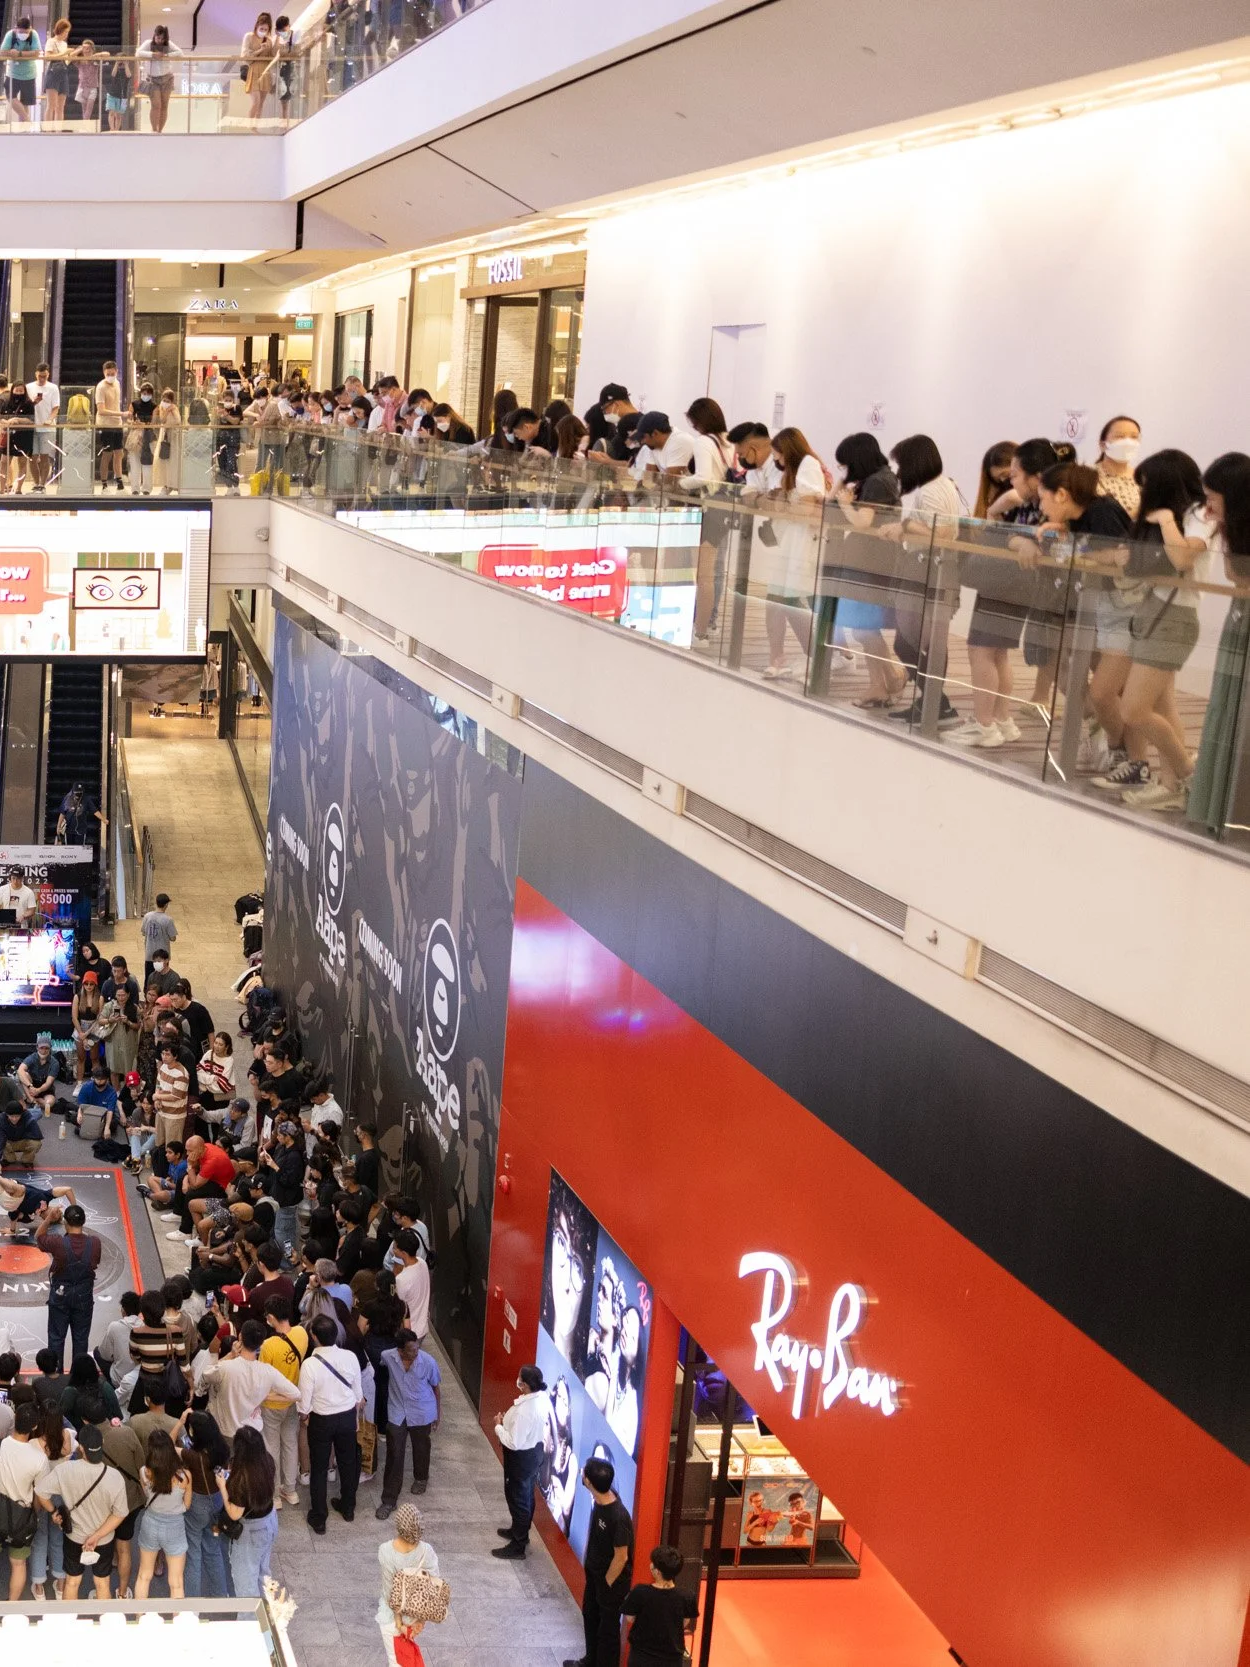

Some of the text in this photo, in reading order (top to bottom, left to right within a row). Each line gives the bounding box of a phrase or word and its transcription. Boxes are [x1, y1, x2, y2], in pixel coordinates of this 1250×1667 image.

[488, 254, 523, 284] FOSSIL
[190, 298, 239, 310] ZARA
[39, 893, 73, 905] $5000
[315, 892, 347, 968] Aape
[358, 917, 403, 995] COMING SOON
[416, 1026, 461, 1131] Aape
